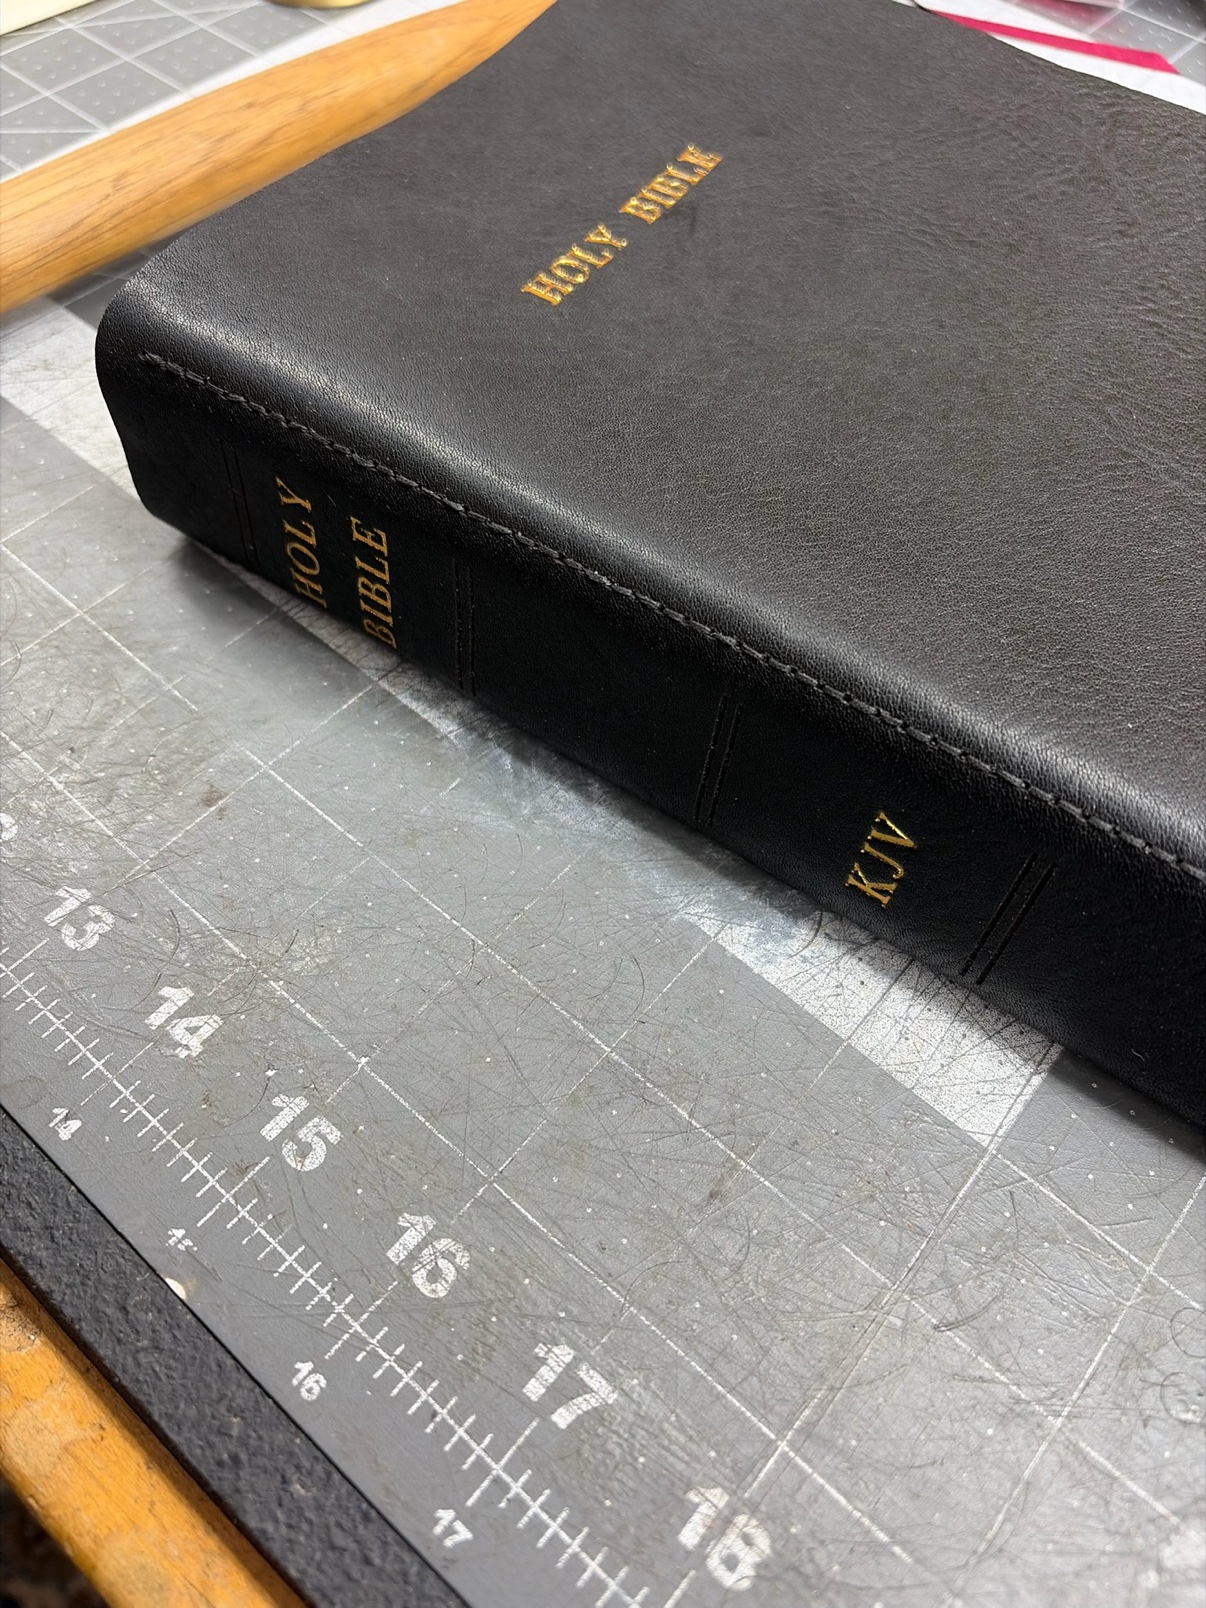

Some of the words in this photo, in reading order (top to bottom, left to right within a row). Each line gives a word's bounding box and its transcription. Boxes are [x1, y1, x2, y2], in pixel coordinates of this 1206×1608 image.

[520, 223, 628, 306] HOLY
[618, 142, 724, 225] BIBLE
[275, 476, 328, 609] HOLY
[350, 516, 397, 649] BIBLE
[844, 811, 917, 909] KJV
[44, 886, 116, 951] 13
[145, 986, 224, 1058] 14
[48, 1107, 82, 1141] 14
[259, 1093, 344, 1172] 15
[386, 1212, 471, 1298] 16
[291, 1361, 327, 1400] 16
[523, 1342, 618, 1429] 17
[432, 1508, 473, 1548] 17
[677, 1486, 771, 1591] 18
